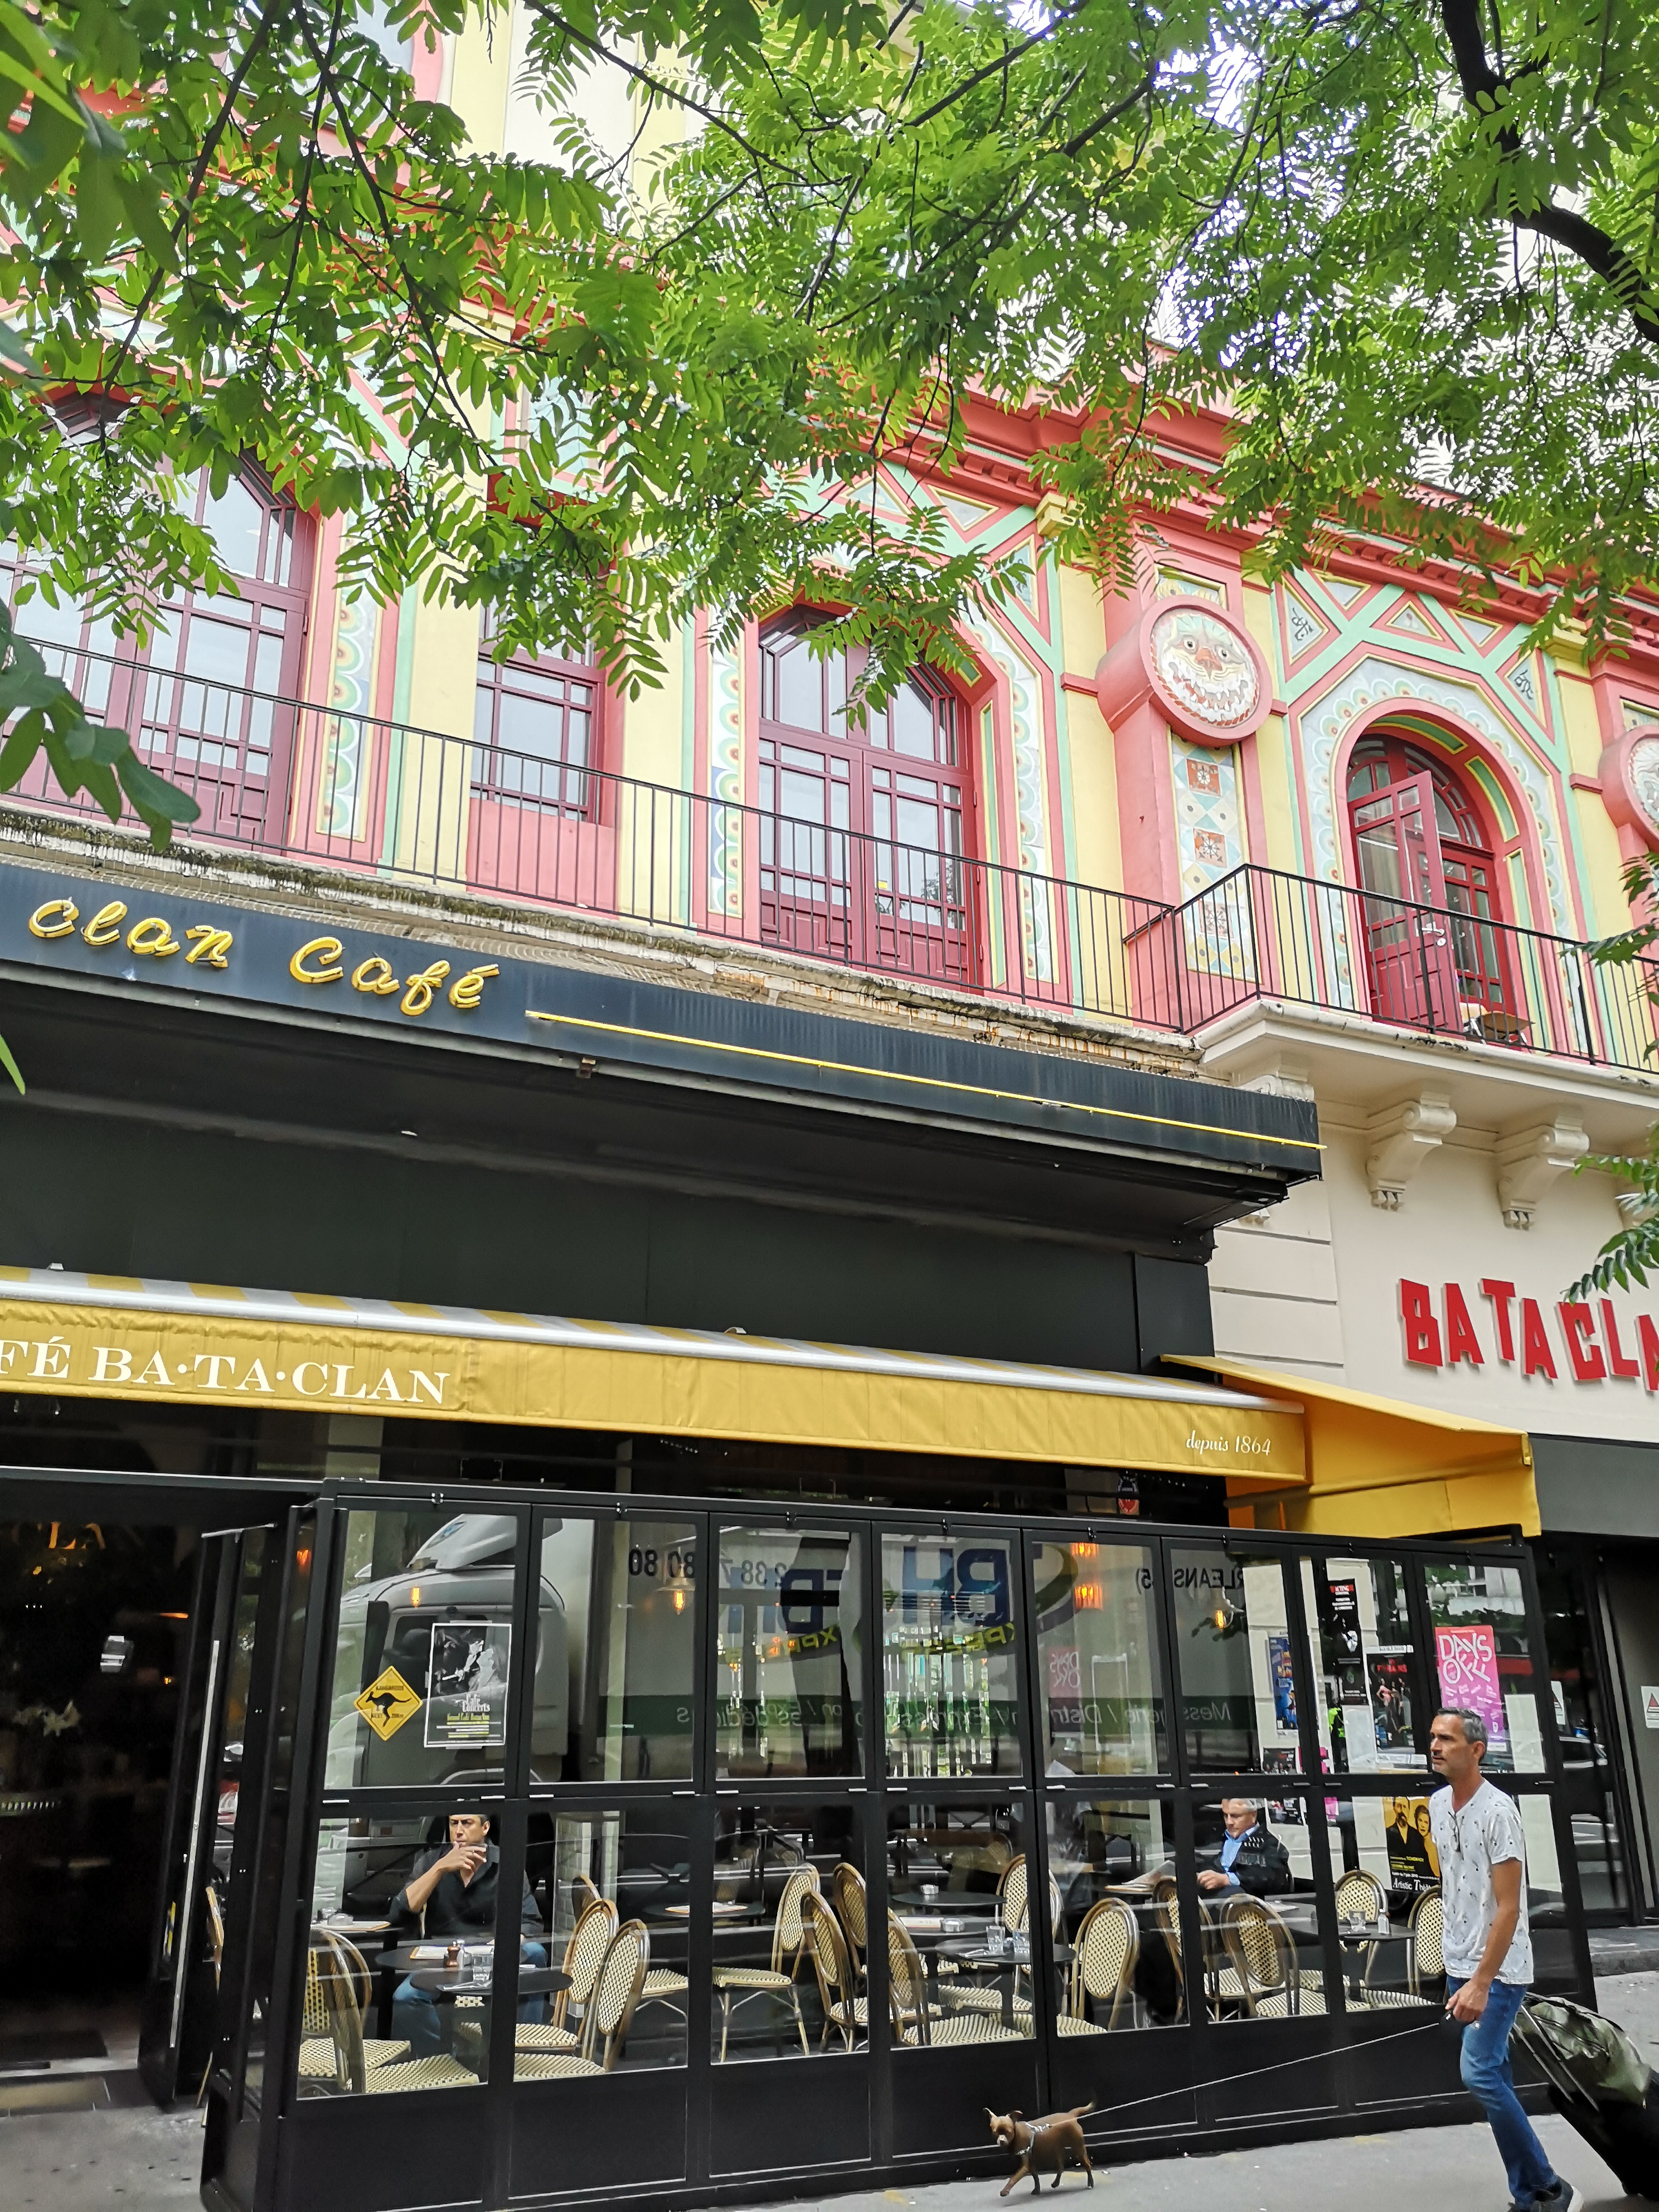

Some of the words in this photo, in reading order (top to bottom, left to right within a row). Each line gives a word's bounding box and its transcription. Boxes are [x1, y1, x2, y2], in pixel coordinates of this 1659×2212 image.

[289, 936, 500, 1016] Café
[1186, 1429, 1229, 1455] depuis
[1235, 1435, 1272, 1456] 1864
[1438, 1632, 1492, 1662] DAYS
[1442, 1653, 1491, 1684] OFF
